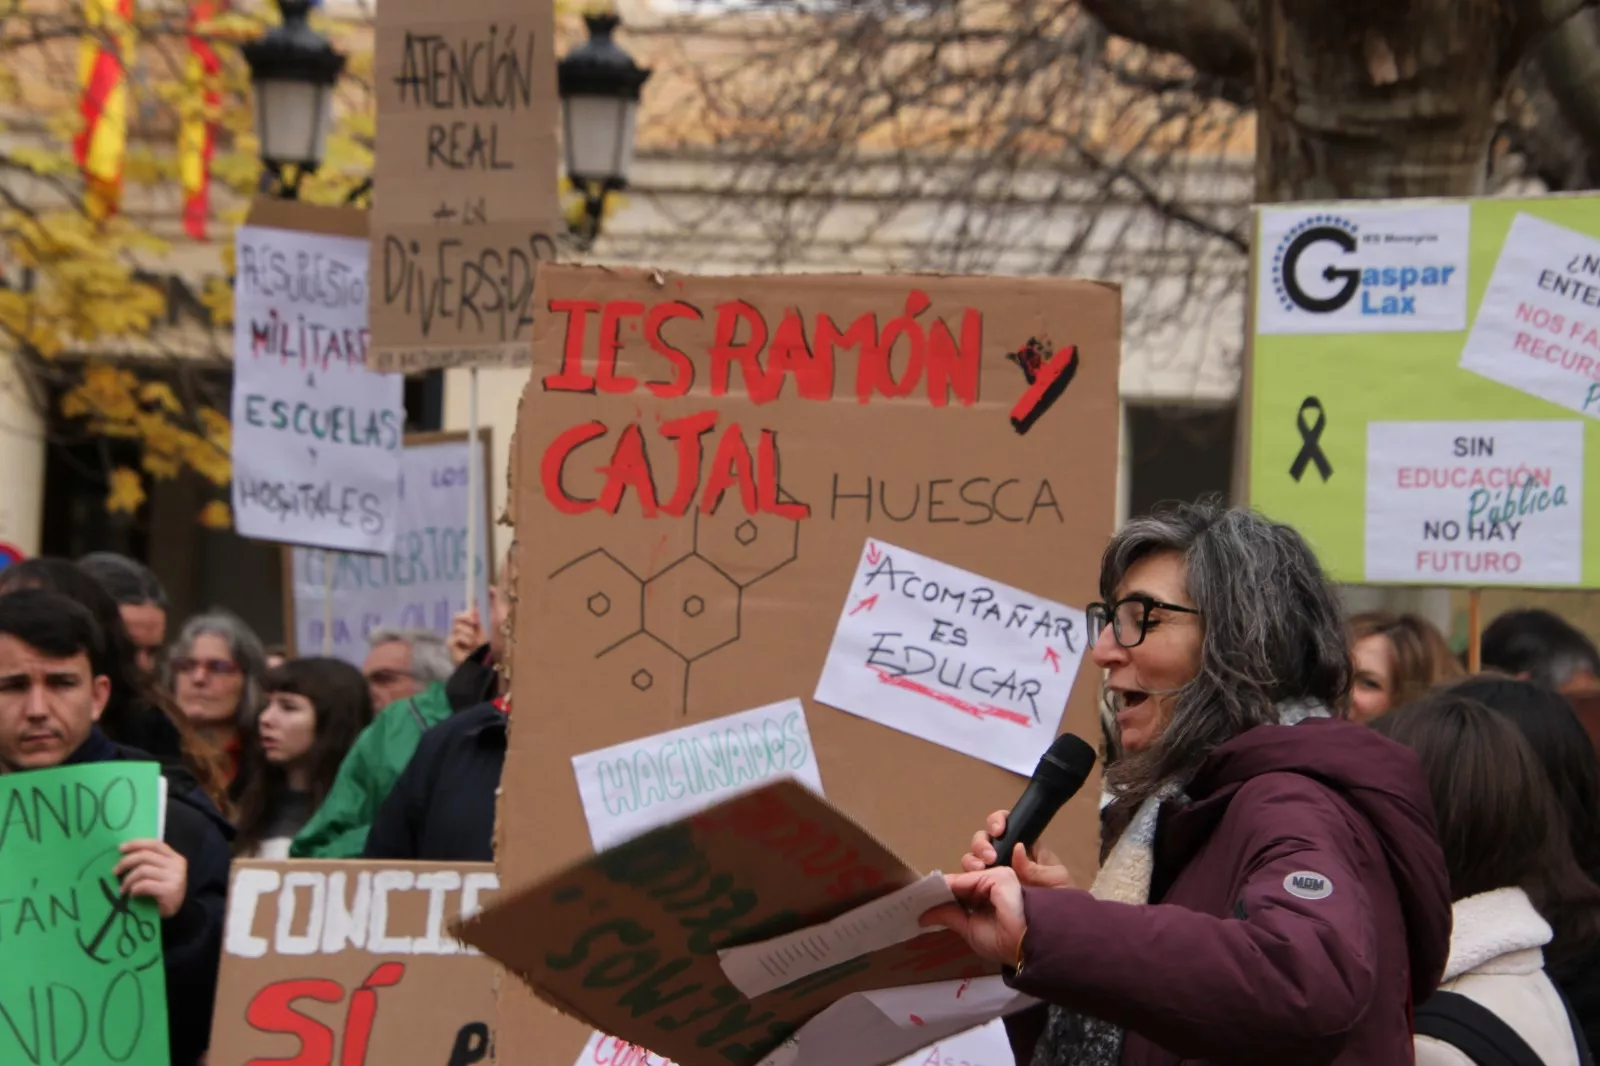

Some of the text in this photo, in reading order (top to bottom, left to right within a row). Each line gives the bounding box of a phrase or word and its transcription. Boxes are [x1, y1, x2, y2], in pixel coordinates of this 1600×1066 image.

[427, 122, 513, 171] REAL
[1361, 290, 1416, 315] Lax
[1538, 269, 1600, 309] ENTE
[542, 299, 703, 398] IES
[709, 290, 983, 407] RAMÓN
[1515, 302, 1600, 349] NOS FA
[245, 394, 398, 451] ESCUELAS
[540, 410, 1065, 525] CAJAL HUESCA
[1453, 436, 1494, 458] SIN
[1397, 462, 1552, 489] EDUCACIÓN
[1467, 475, 1568, 534] Pública
[1424, 520, 1522, 541] NO HAY
[1416, 551, 1522, 573] FUTURO
[865, 555, 1076, 653] ACOMPAÑAR
[930, 618, 968, 647] ES
[866, 632, 1041, 724] EDUCAR
[247, 962, 405, 1066] SÍ
